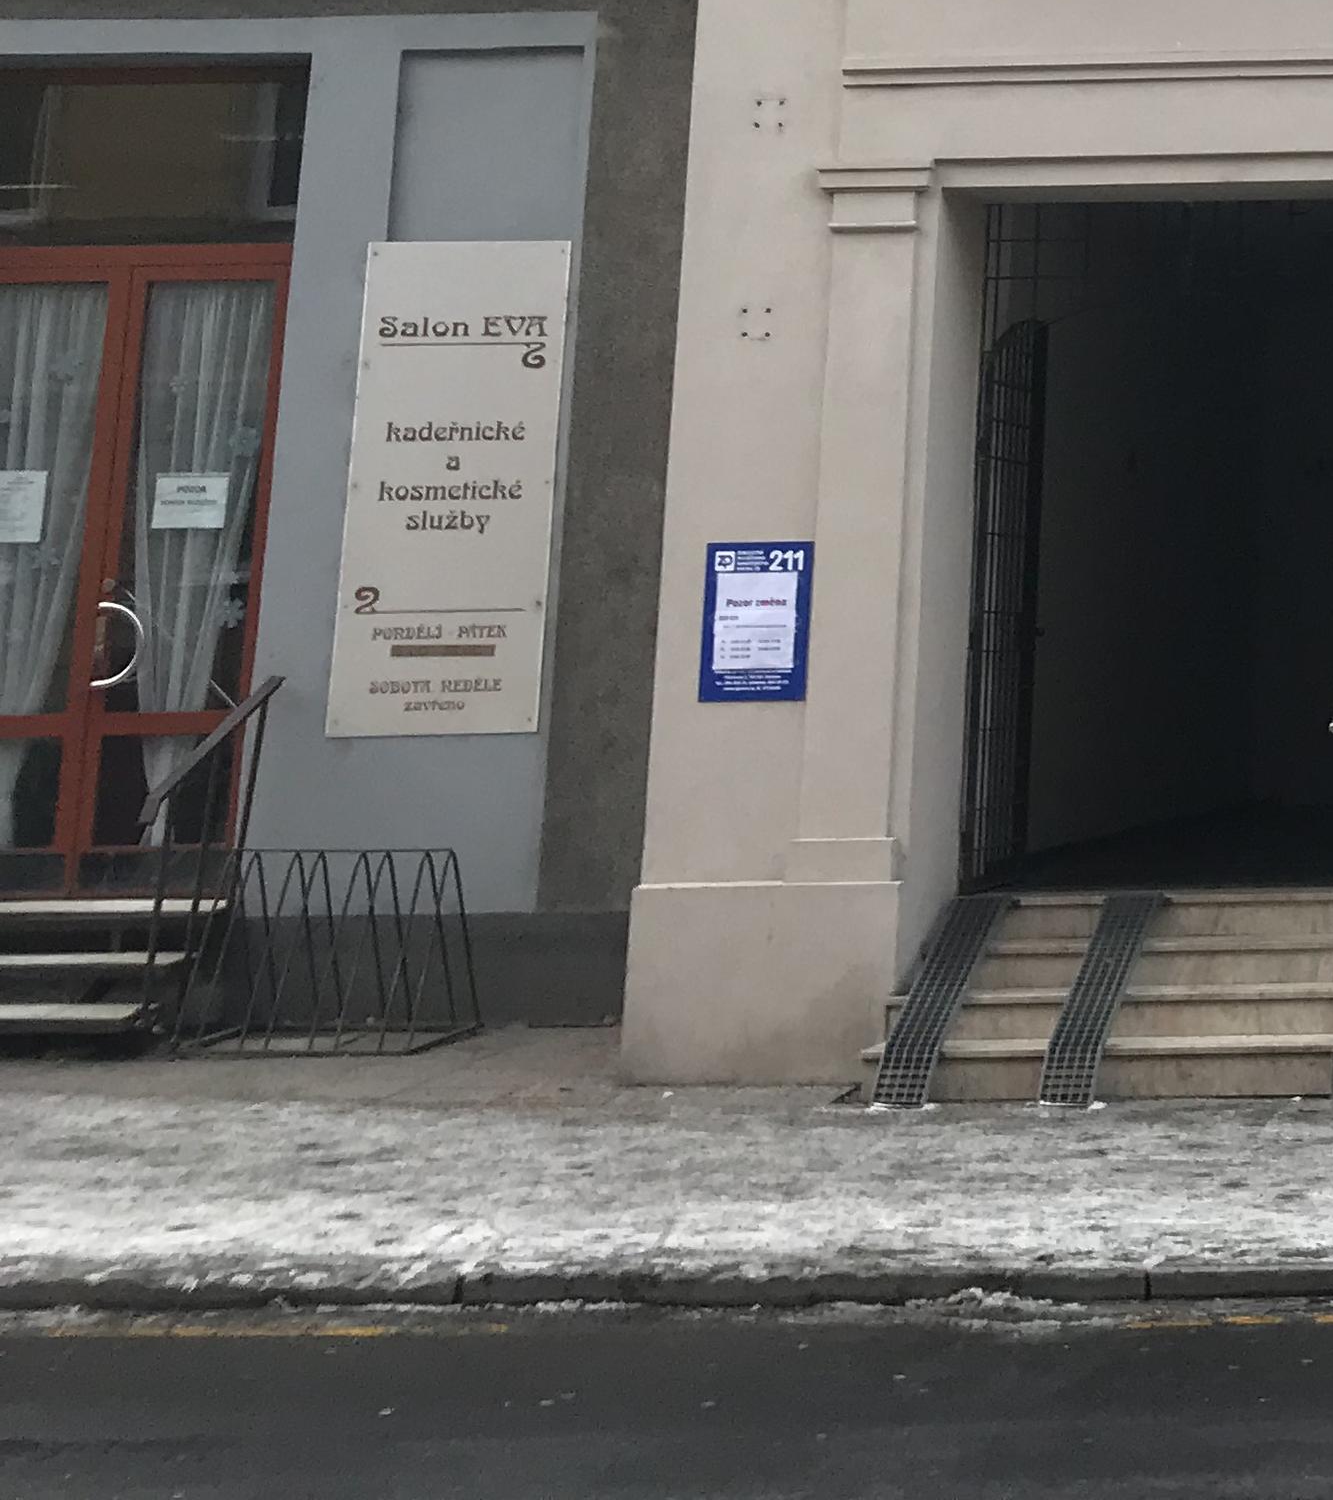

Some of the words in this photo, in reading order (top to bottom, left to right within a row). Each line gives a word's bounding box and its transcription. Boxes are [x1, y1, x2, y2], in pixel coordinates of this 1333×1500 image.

[378, 316, 470, 338] Salon
[480, 315, 549, 338] EVA
[386, 421, 526, 442] kadeřnické
[445, 455, 461, 471] a
[378, 479, 523, 501] kosmetické
[405, 509, 491, 534] služby
[768, 549, 805, 572] 211
[369, 679, 431, 694] SOBOTA
[441, 676, 503, 693] NEDĚLE
